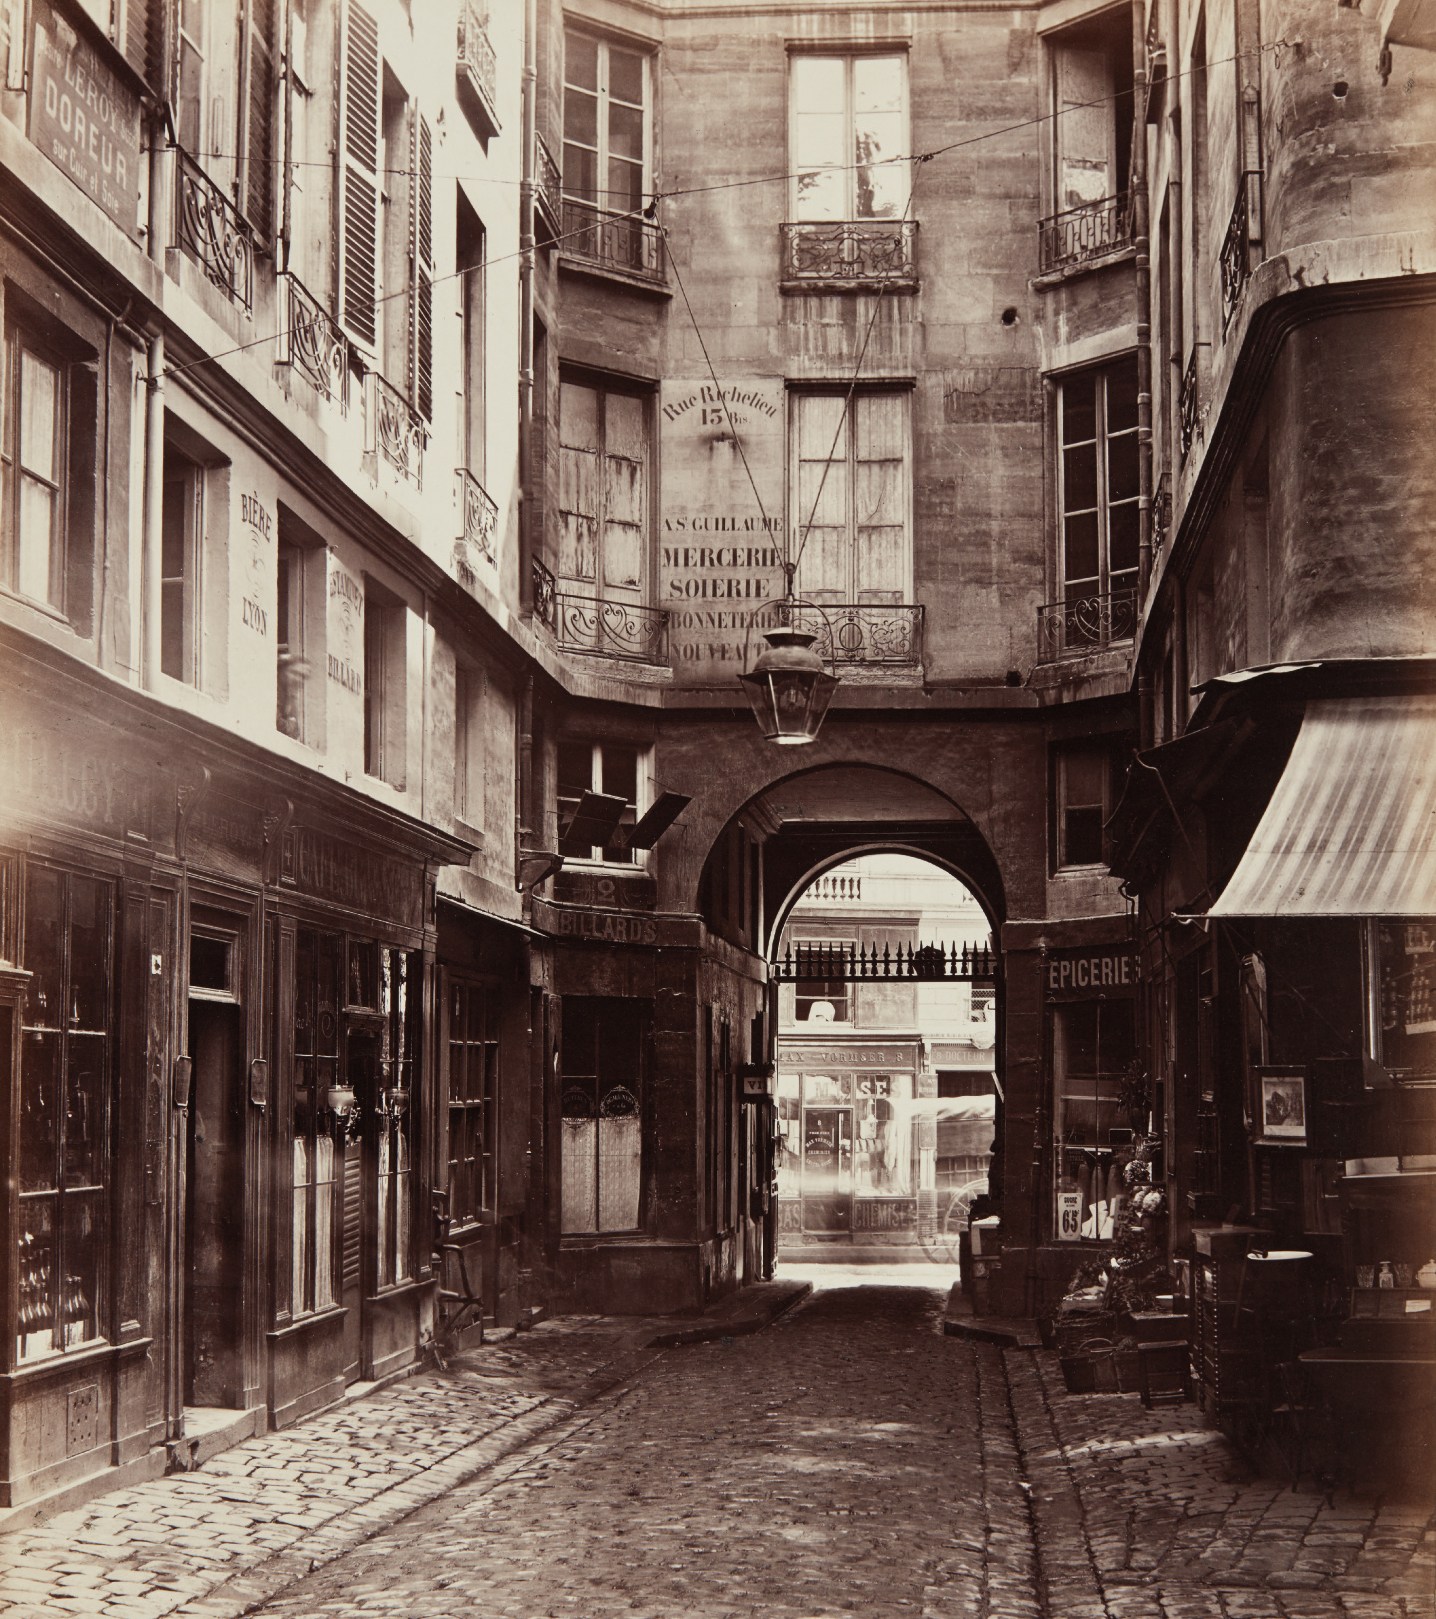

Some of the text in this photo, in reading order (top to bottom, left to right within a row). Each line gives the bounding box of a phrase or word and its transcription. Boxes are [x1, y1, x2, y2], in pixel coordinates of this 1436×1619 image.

[45, 75, 126, 190] DOREUR
[53, 139, 67, 161] sur
[90, 171, 98, 194] et
[662, 386, 777, 421] Rue Richelieu
[702, 408, 723, 425] 15
[241, 491, 272, 543] BIÈRE
[692, 517, 783, 531] GUILLAUME
[662, 547, 783, 567] MERCERIE
[669, 578, 770, 598] SOIERIE
[242, 597, 267, 638] LYON
[671, 612, 778, 629] BONNETERIE
[559, 911, 657, 944] BILLARDS
